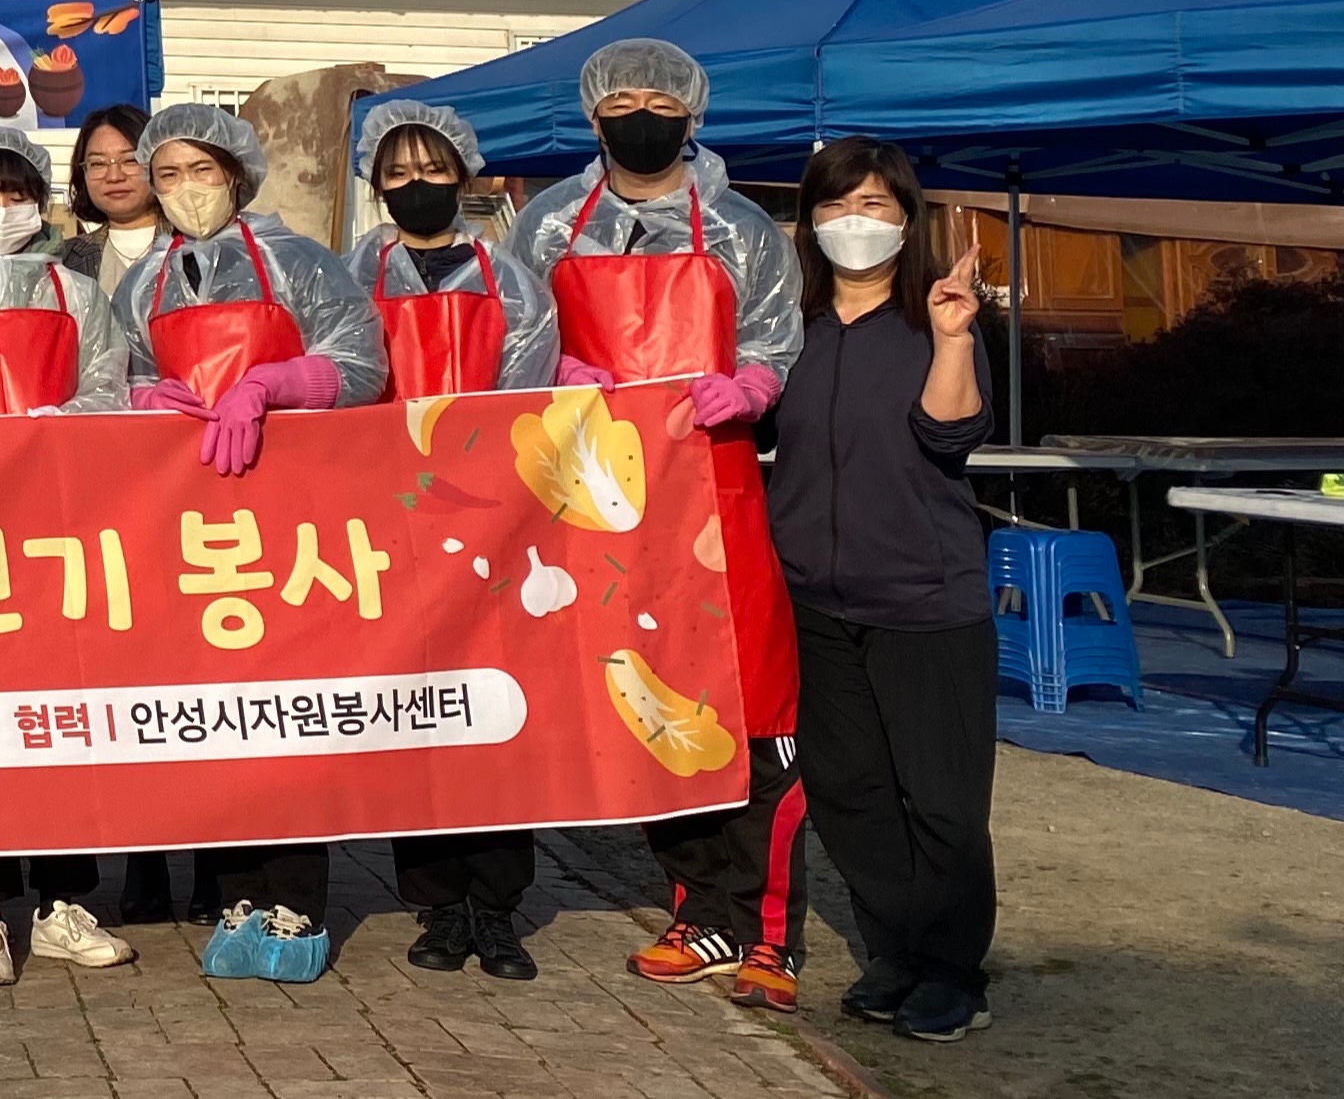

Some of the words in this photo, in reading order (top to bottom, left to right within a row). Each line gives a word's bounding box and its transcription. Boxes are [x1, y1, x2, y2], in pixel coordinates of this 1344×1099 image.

[177, 509, 392, 650] 봉사
[14, 703, 93, 749] 협력
[131, 682, 474, 747] 안성시자원봉사센터
